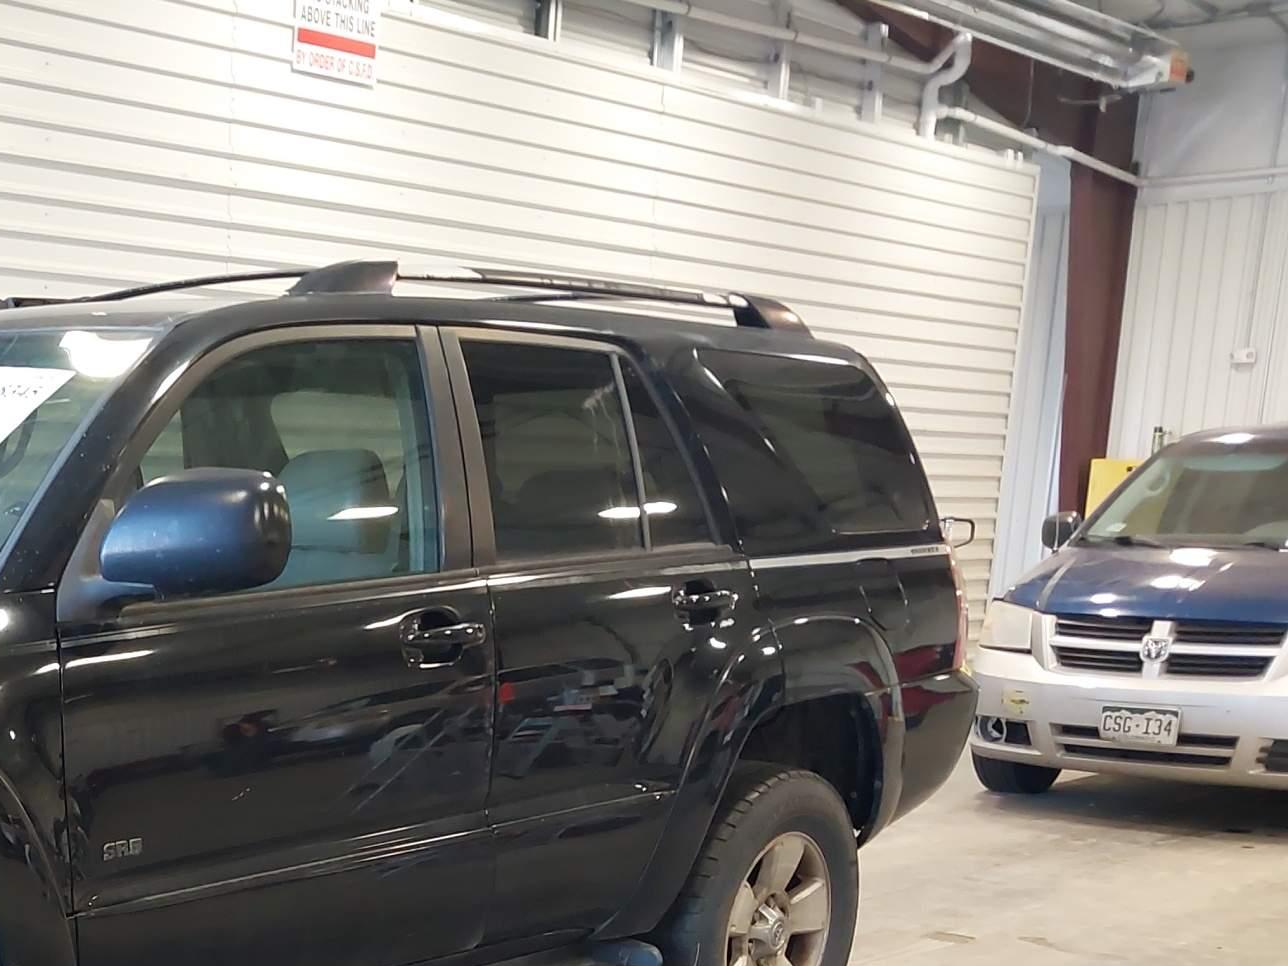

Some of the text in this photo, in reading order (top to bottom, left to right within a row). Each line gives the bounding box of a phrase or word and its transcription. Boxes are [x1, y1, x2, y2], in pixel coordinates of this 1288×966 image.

[301, 5, 376, 38] ABOVE THIS LINE
[296, 48, 306, 65] BY
